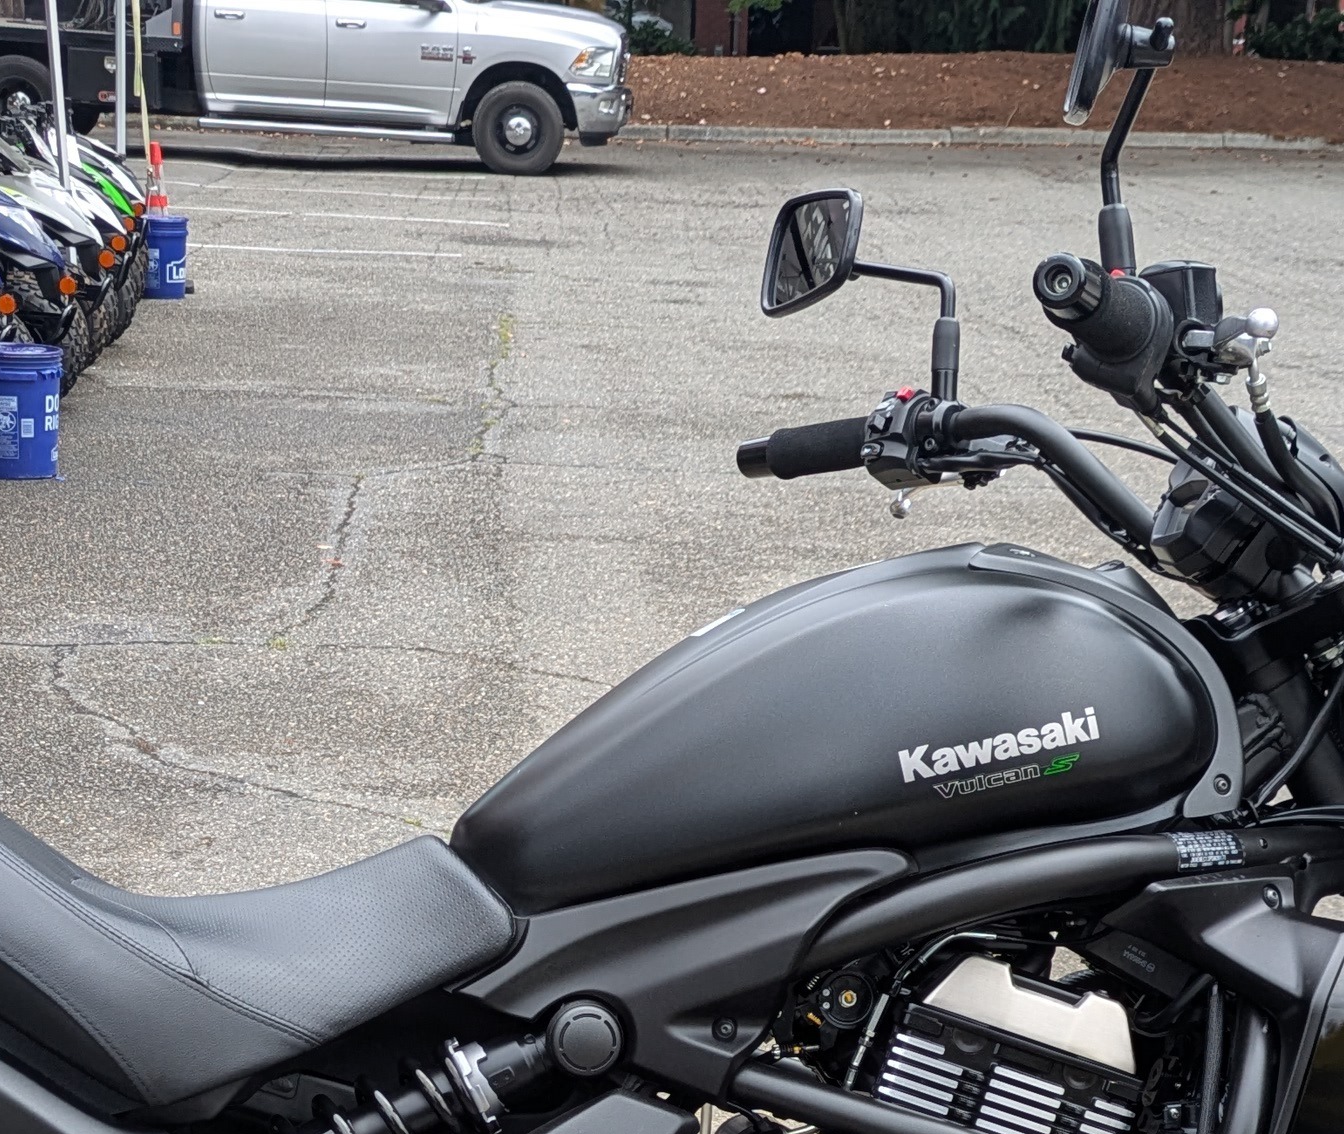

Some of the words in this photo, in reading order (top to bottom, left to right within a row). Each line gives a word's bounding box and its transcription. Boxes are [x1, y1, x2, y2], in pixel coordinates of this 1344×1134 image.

[898, 706, 1100, 784] Kawasaki
[933, 763, 1041, 799] Vulcan
[1043, 751, 1081, 776] S
